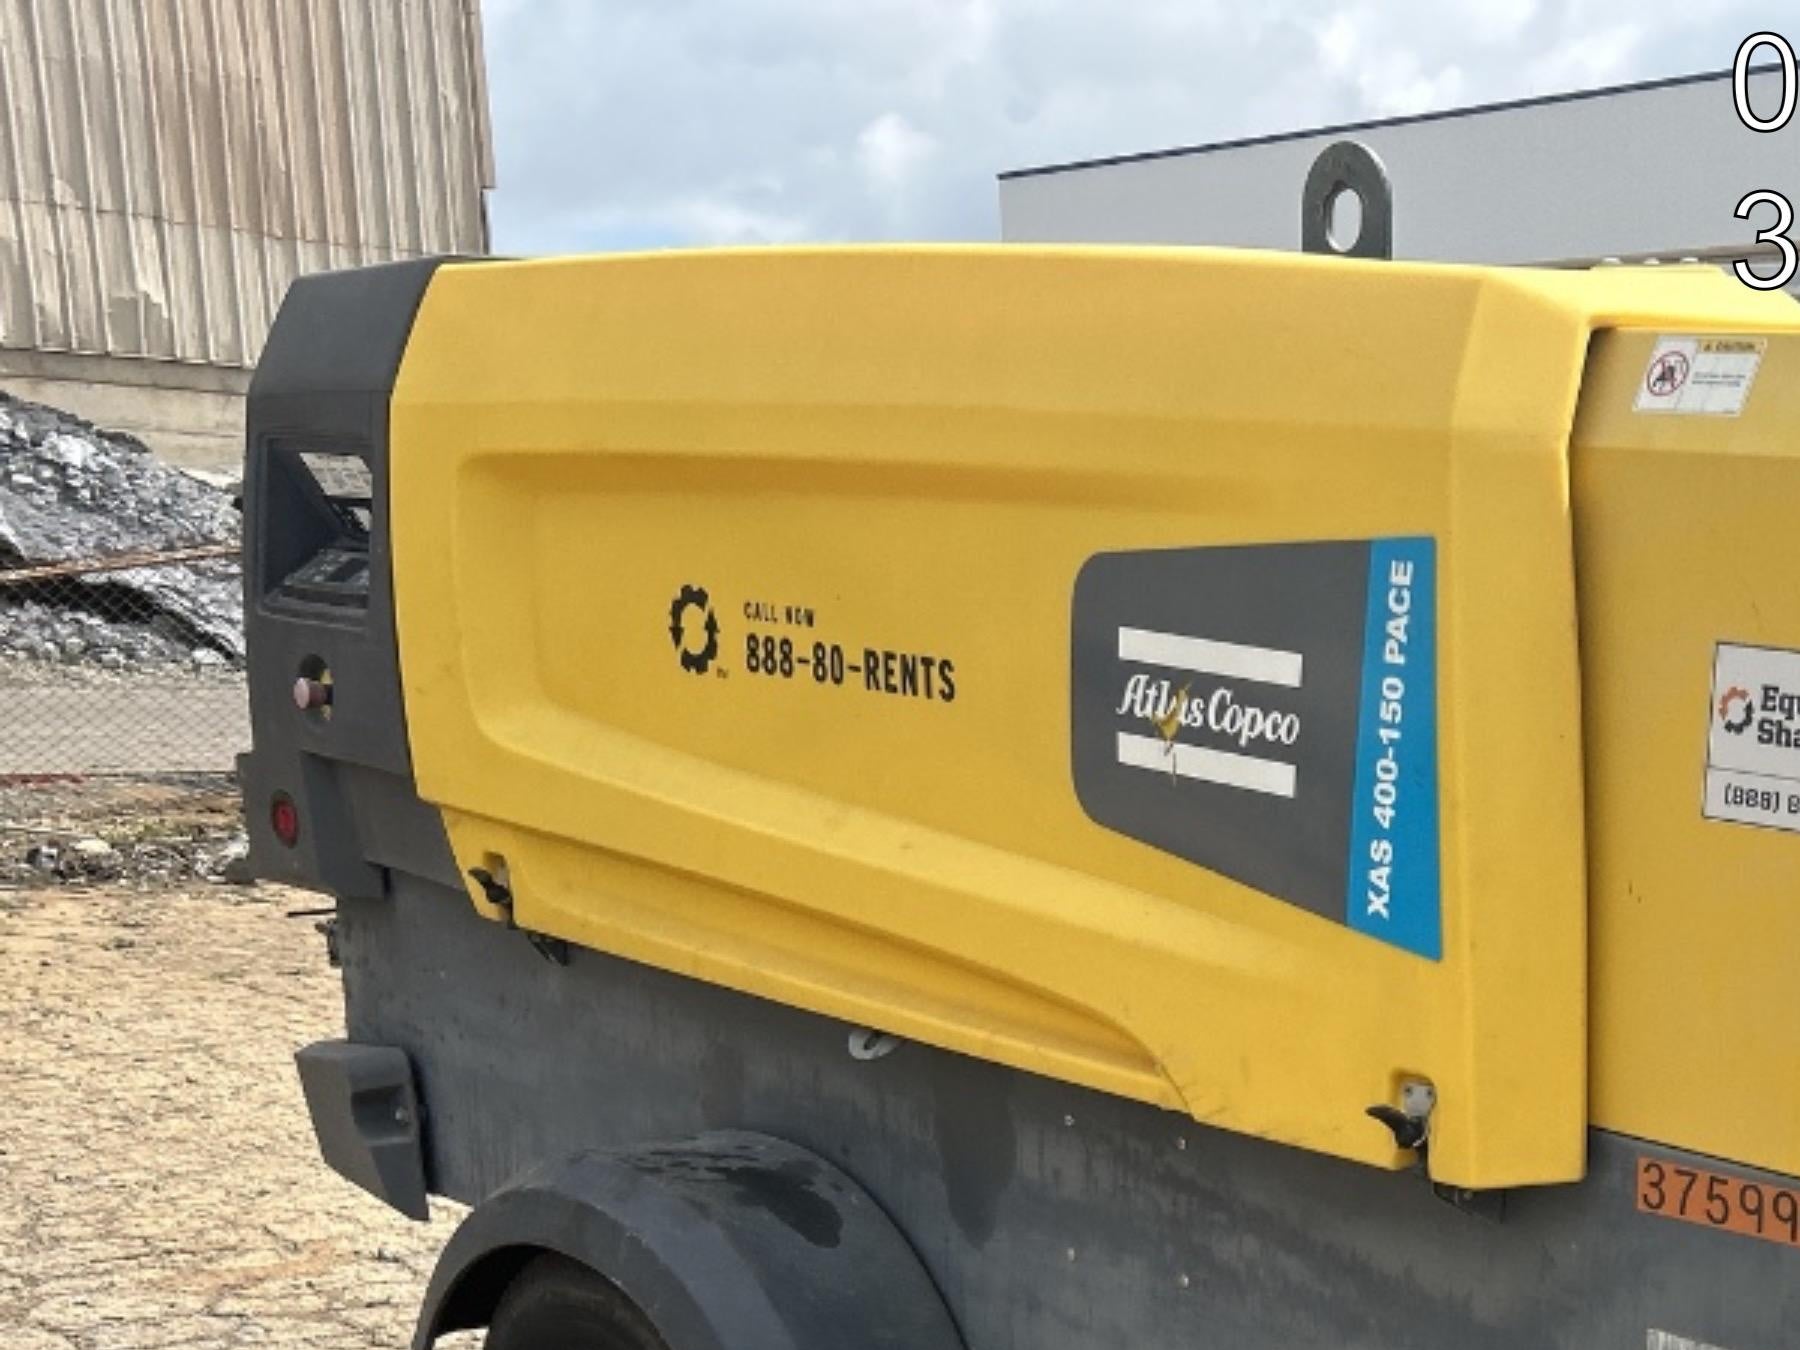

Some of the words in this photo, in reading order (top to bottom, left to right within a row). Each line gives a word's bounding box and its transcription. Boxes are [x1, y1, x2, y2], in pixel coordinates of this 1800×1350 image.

[743, 601, 778, 623] CALL
[784, 606, 815, 628] NOW
[1383, 559, 1415, 664] PACE
[746, 632, 957, 703] 888-80-RENTS
[1208, 689, 1301, 746] Copco
[1371, 676, 1404, 831] 400-150
[1366, 840, 1394, 918] XAS
